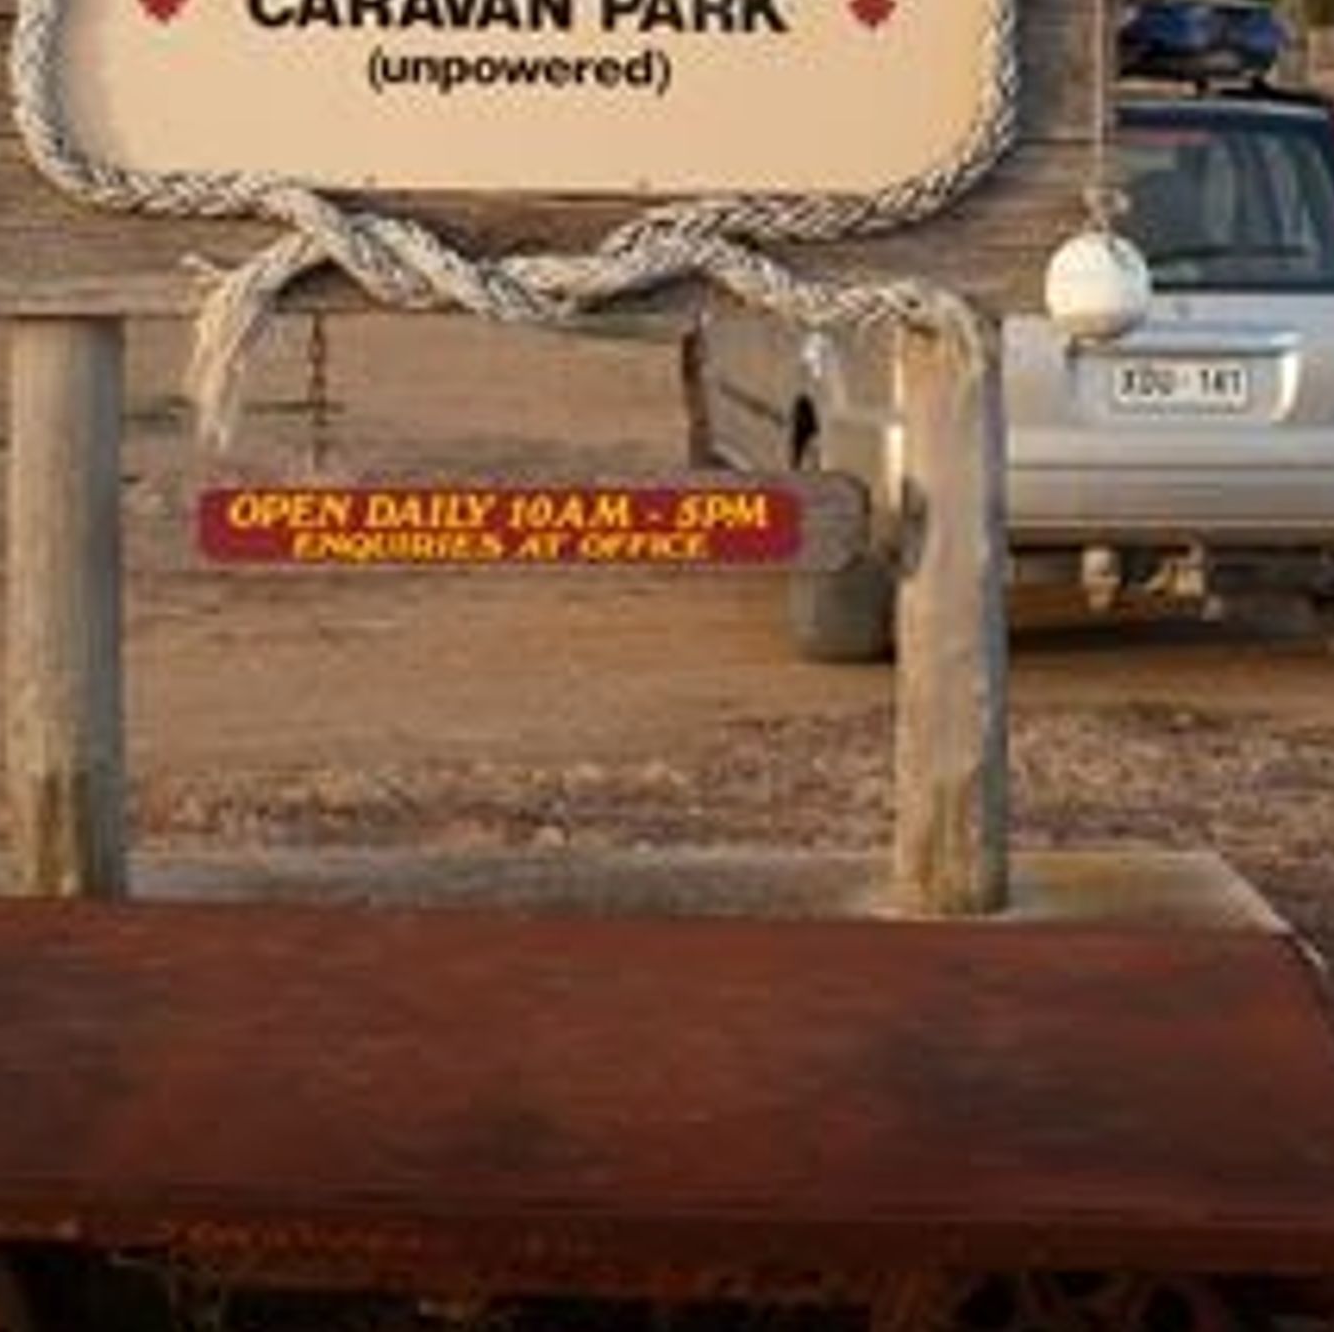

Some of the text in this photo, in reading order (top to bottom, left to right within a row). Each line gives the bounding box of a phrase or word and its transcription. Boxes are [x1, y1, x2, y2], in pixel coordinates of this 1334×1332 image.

[367, 48, 673, 94] (unpowered)
[229, 493, 351, 528] OPEN
[364, 493, 497, 528] DAILY
[509, 493, 633, 528] 10AM
[676, 494, 769, 528] 5PM
[292, 532, 710, 560] ENQUIRIES AT OFFICE
